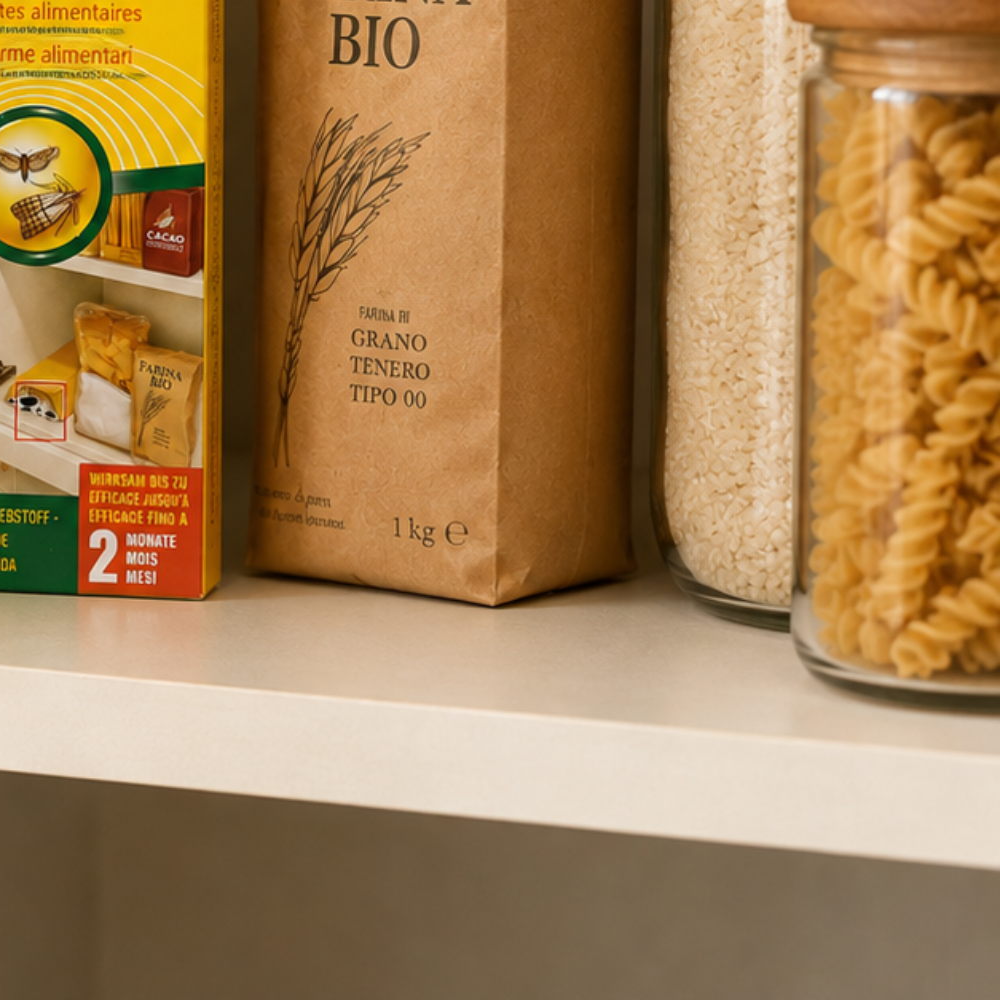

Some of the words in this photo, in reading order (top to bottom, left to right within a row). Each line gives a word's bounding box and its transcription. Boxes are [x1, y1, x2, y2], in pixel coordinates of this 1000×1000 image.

[31, 2, 143, 22] alimentaires
[329, 13, 420, 69] BIO
[40, 45, 133, 65] alimentari
[146, 230, 185, 244] CACAO
[351, 328, 427, 352] GRANO
[349, 355, 430, 380] TENERO
[349, 383, 397, 406] TIPO
[404, 389, 427, 409] 00
[126, 533, 177, 549] MONATE
[408, 517, 436, 548] kg
[89, 529, 118, 584] 2
[126, 551, 159, 567] MOIS
[126, 570, 157, 586] MESI
